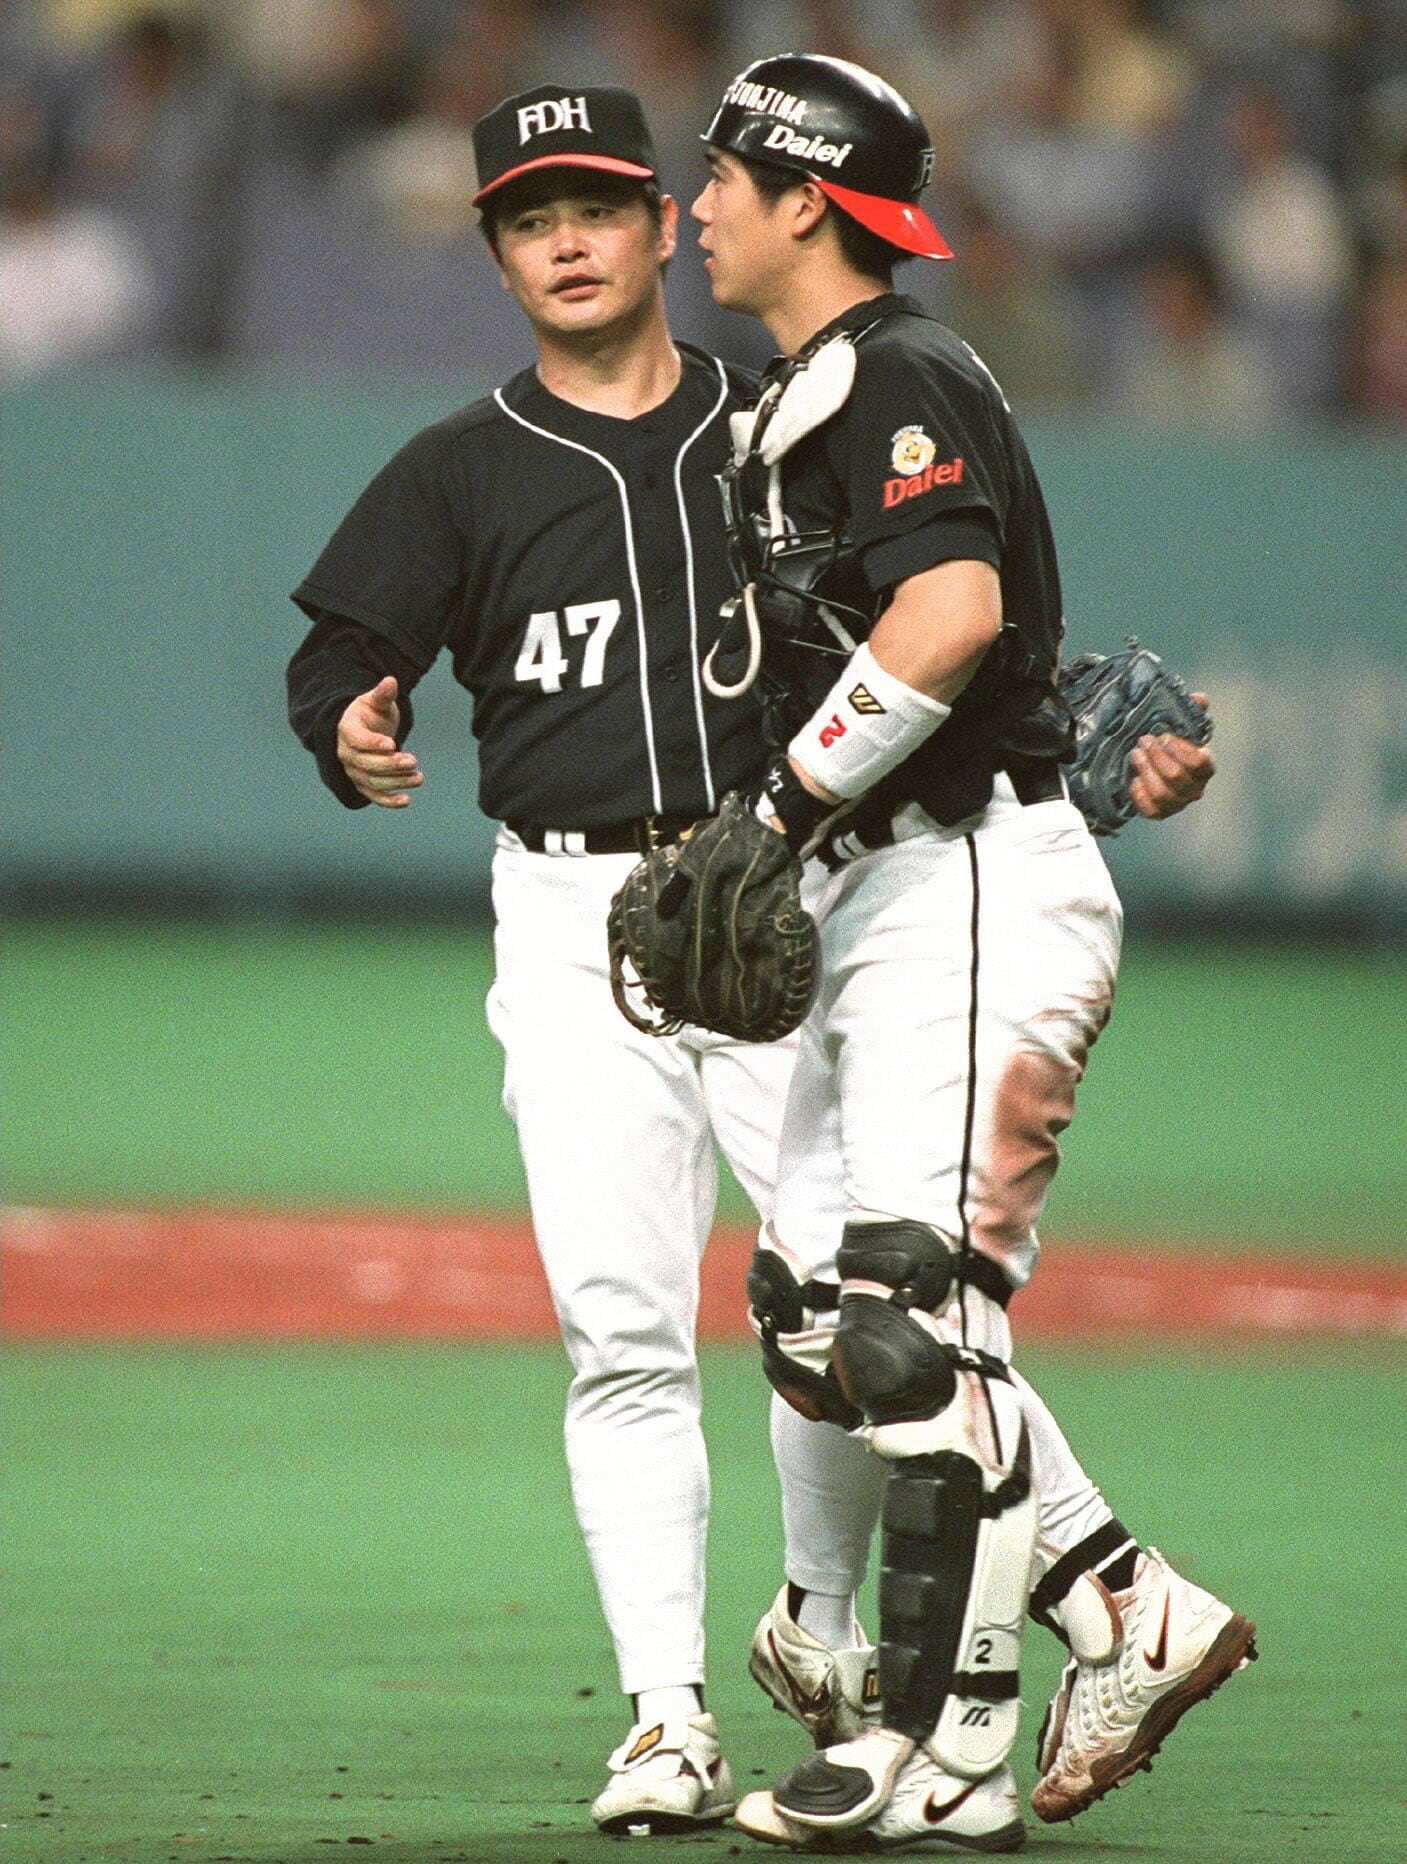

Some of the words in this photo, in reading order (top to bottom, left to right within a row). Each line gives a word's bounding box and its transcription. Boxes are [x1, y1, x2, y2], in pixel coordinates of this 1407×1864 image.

[517, 97, 593, 146] FDH
[763, 124, 853, 167] Daiei
[882, 456, 964, 509] Daiei
[514, 599, 621, 694] 47
[819, 714, 847, 748] 2
[975, 1638, 993, 1664] 2
